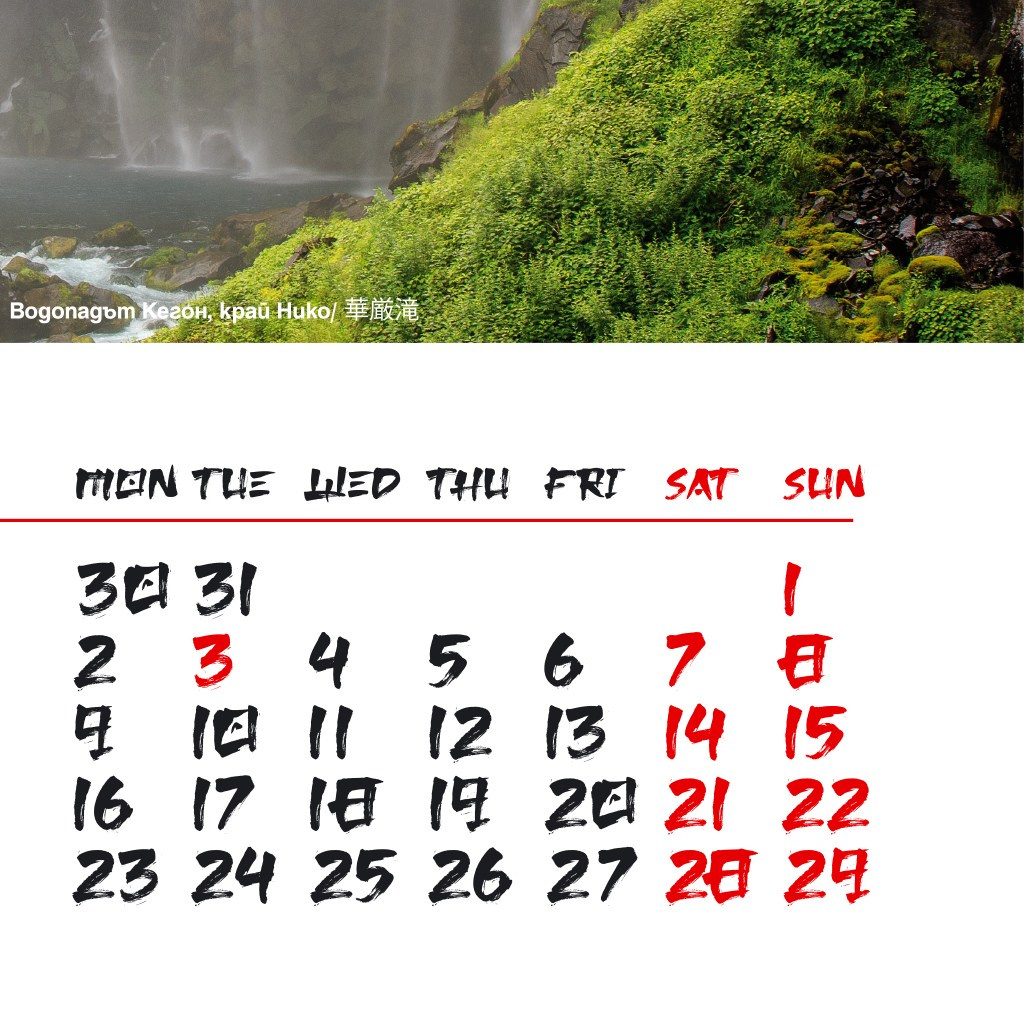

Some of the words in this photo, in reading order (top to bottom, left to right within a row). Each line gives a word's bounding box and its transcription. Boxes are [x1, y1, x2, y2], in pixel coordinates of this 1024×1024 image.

[76, 465, 178, 502] MON
[191, 466, 275, 501] TUE
[304, 466, 400, 503] WED
[426, 467, 509, 502] THU
[544, 467, 625, 502] FRI
[665, 467, 739, 502] SAT
[783, 464, 866, 501] SUN
[77, 561, 172, 618] 30
[194, 561, 258, 617] 31
[784, 561, 802, 617] 1
[74, 634, 117, 691] 2
[192, 633, 234, 689] 3
[309, 632, 350, 690] 4
[428, 634, 471, 689] 5
[544, 632, 584, 688] 6
[665, 632, 707, 688] 7
[777, 634, 834, 690] 8
[74, 704, 114, 761] 9
[192, 704, 261, 760] 10
[309, 704, 354, 760] 11
[428, 704, 493, 763] 12
[546, 704, 607, 760] 13
[665, 703, 727, 762] 14
[784, 704, 848, 761] 15
[73, 775, 134, 832] 16
[193, 774, 256, 832] 17
[309, 776, 384, 833] 18
[429, 775, 491, 833] 19
[545, 776, 637, 835] 20
[663, 776, 731, 835] 21
[781, 777, 870, 835] 22
[72, 848, 159, 907] 23
[190, 847, 277, 907] 24
[309, 848, 398, 907] 25
[427, 847, 513, 907] 26
[546, 847, 638, 907] 27
[664, 848, 759, 907] 28
[783, 847, 871, 907] 29
